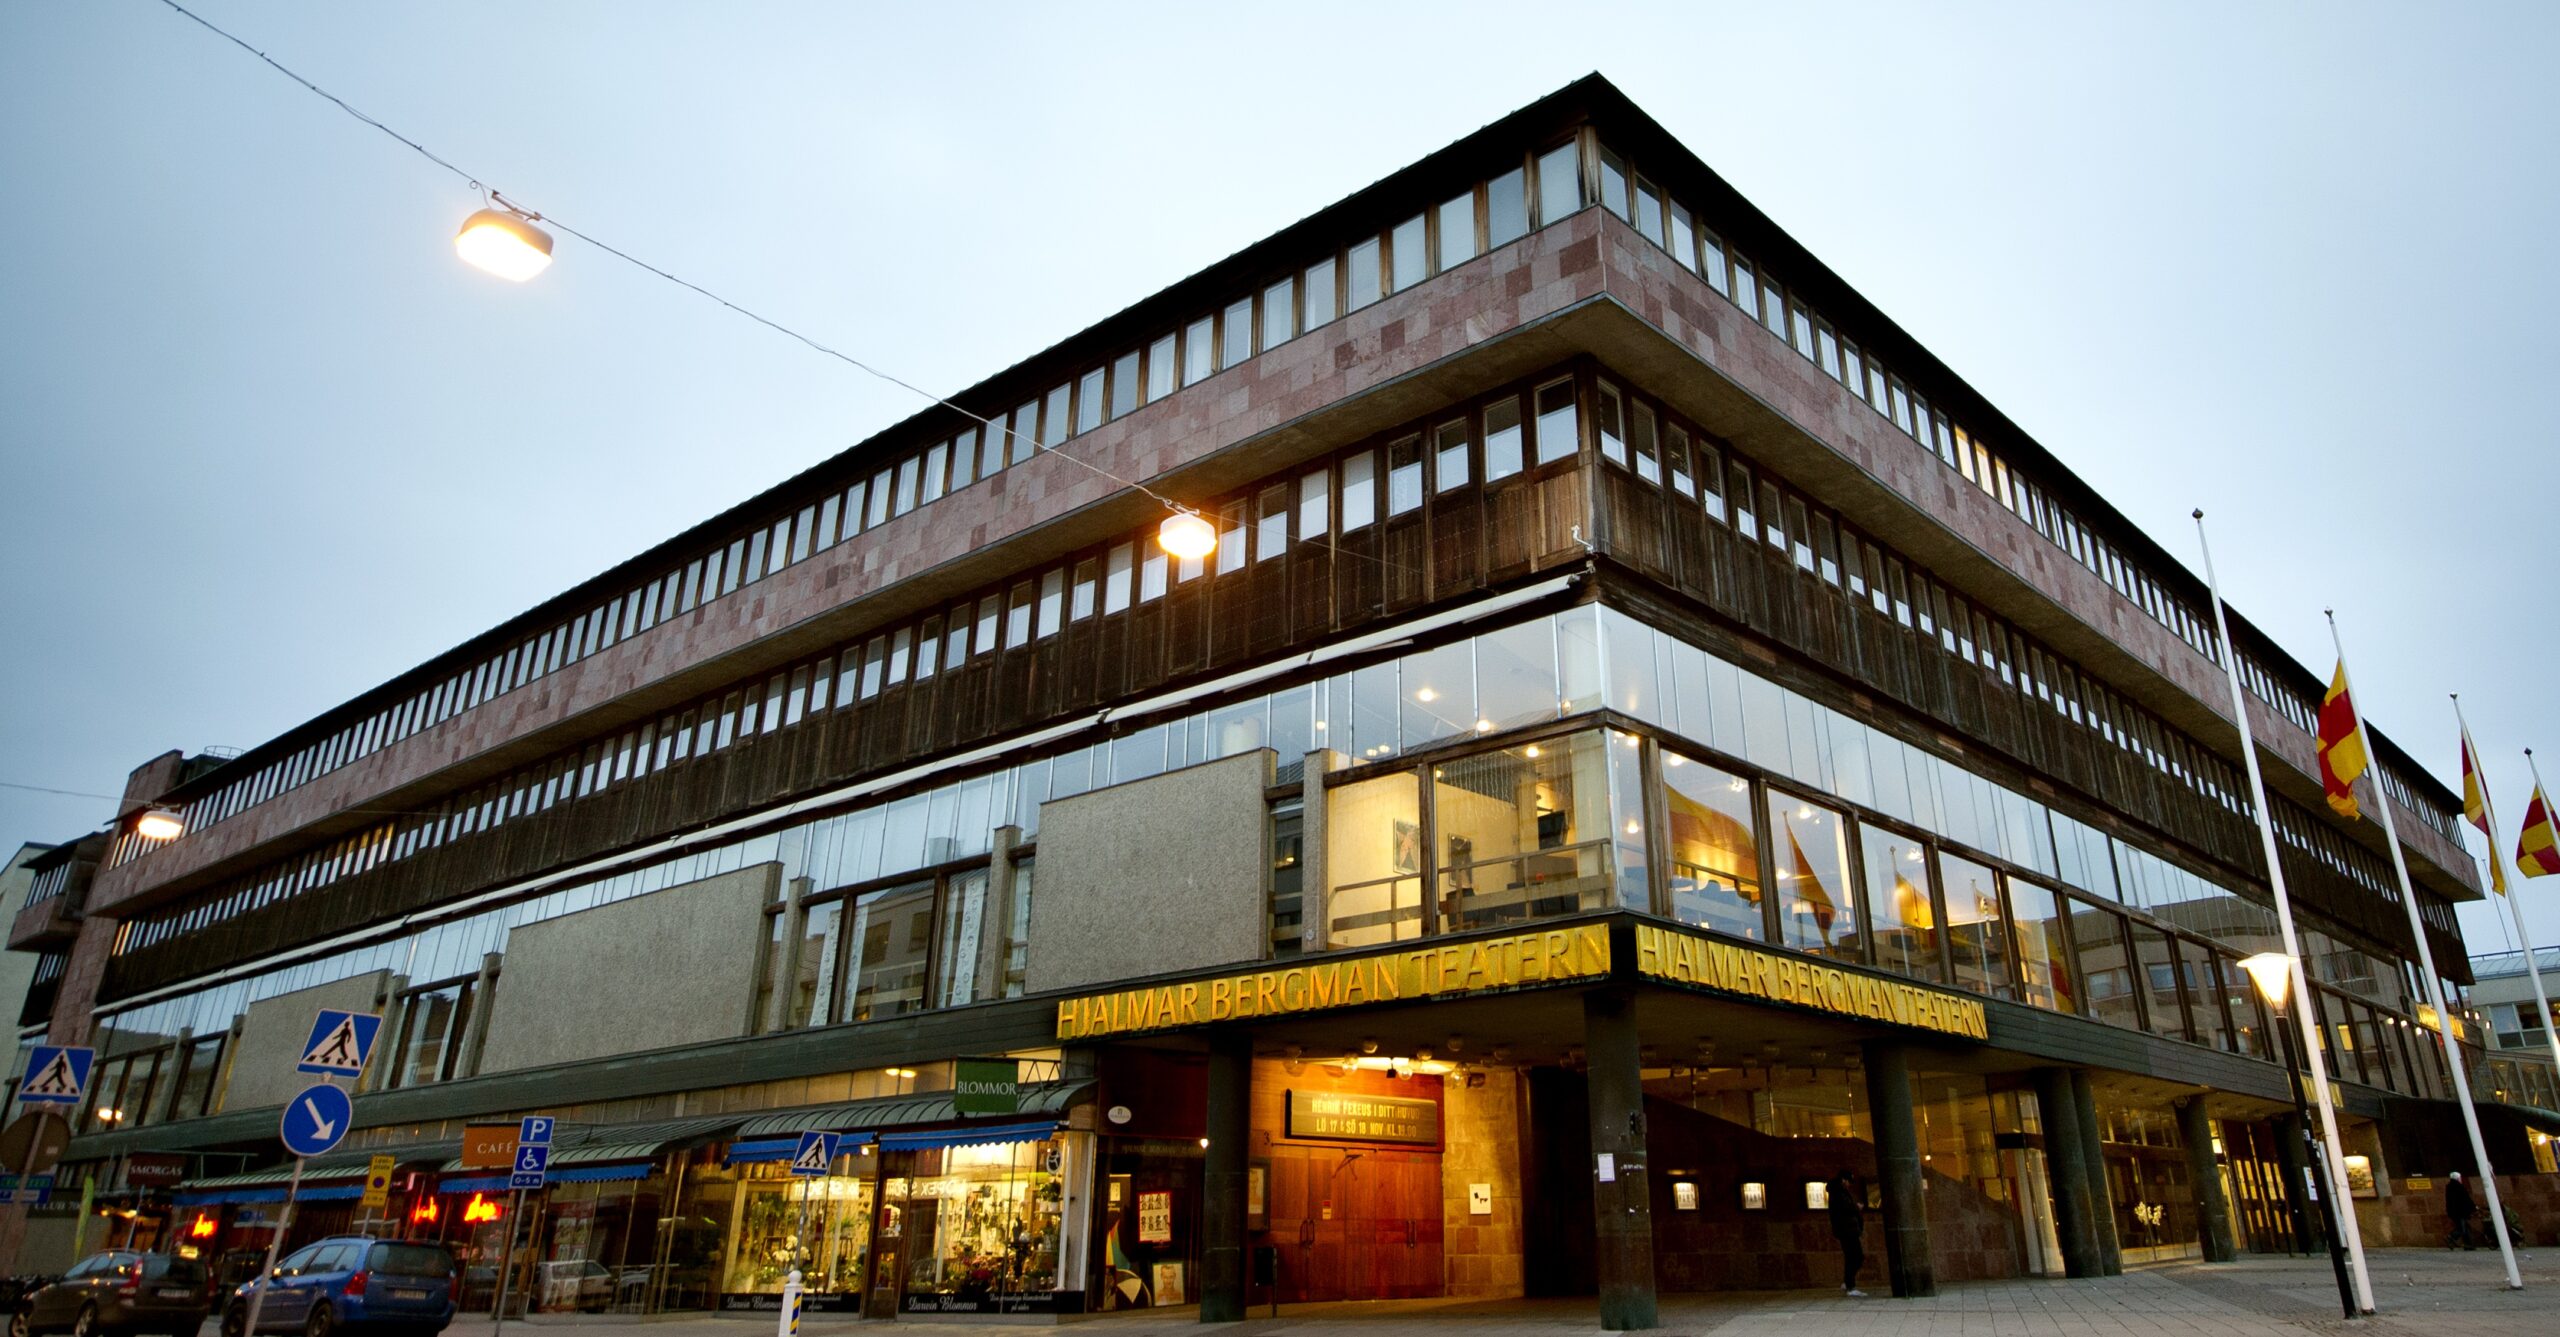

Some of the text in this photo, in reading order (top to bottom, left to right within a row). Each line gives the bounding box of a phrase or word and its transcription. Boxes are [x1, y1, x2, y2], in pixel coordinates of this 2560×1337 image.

[1057, 924, 1610, 1040] HJALMAR BERGMAN TEATERN
[1635, 923, 1988, 1041] HJALMAR BERGMAN TEATERN
[957, 1081, 1017, 1096] BLOMMOR
[1343, 1102, 1372, 1117] FEXEUS
[1378, 1106, 1395, 1118] DITT
[530, 1119, 547, 1141] P
[1316, 1117, 1327, 1132] LÖ
[1330, 1120, 1337, 1133] 17
[1346, 1119, 1356, 1134] SÖ
[1370, 1123, 1384, 1136] NOV
[477, 1140, 513, 1155] CAFÉ
[940, 1295, 978, 1311] Blommor
